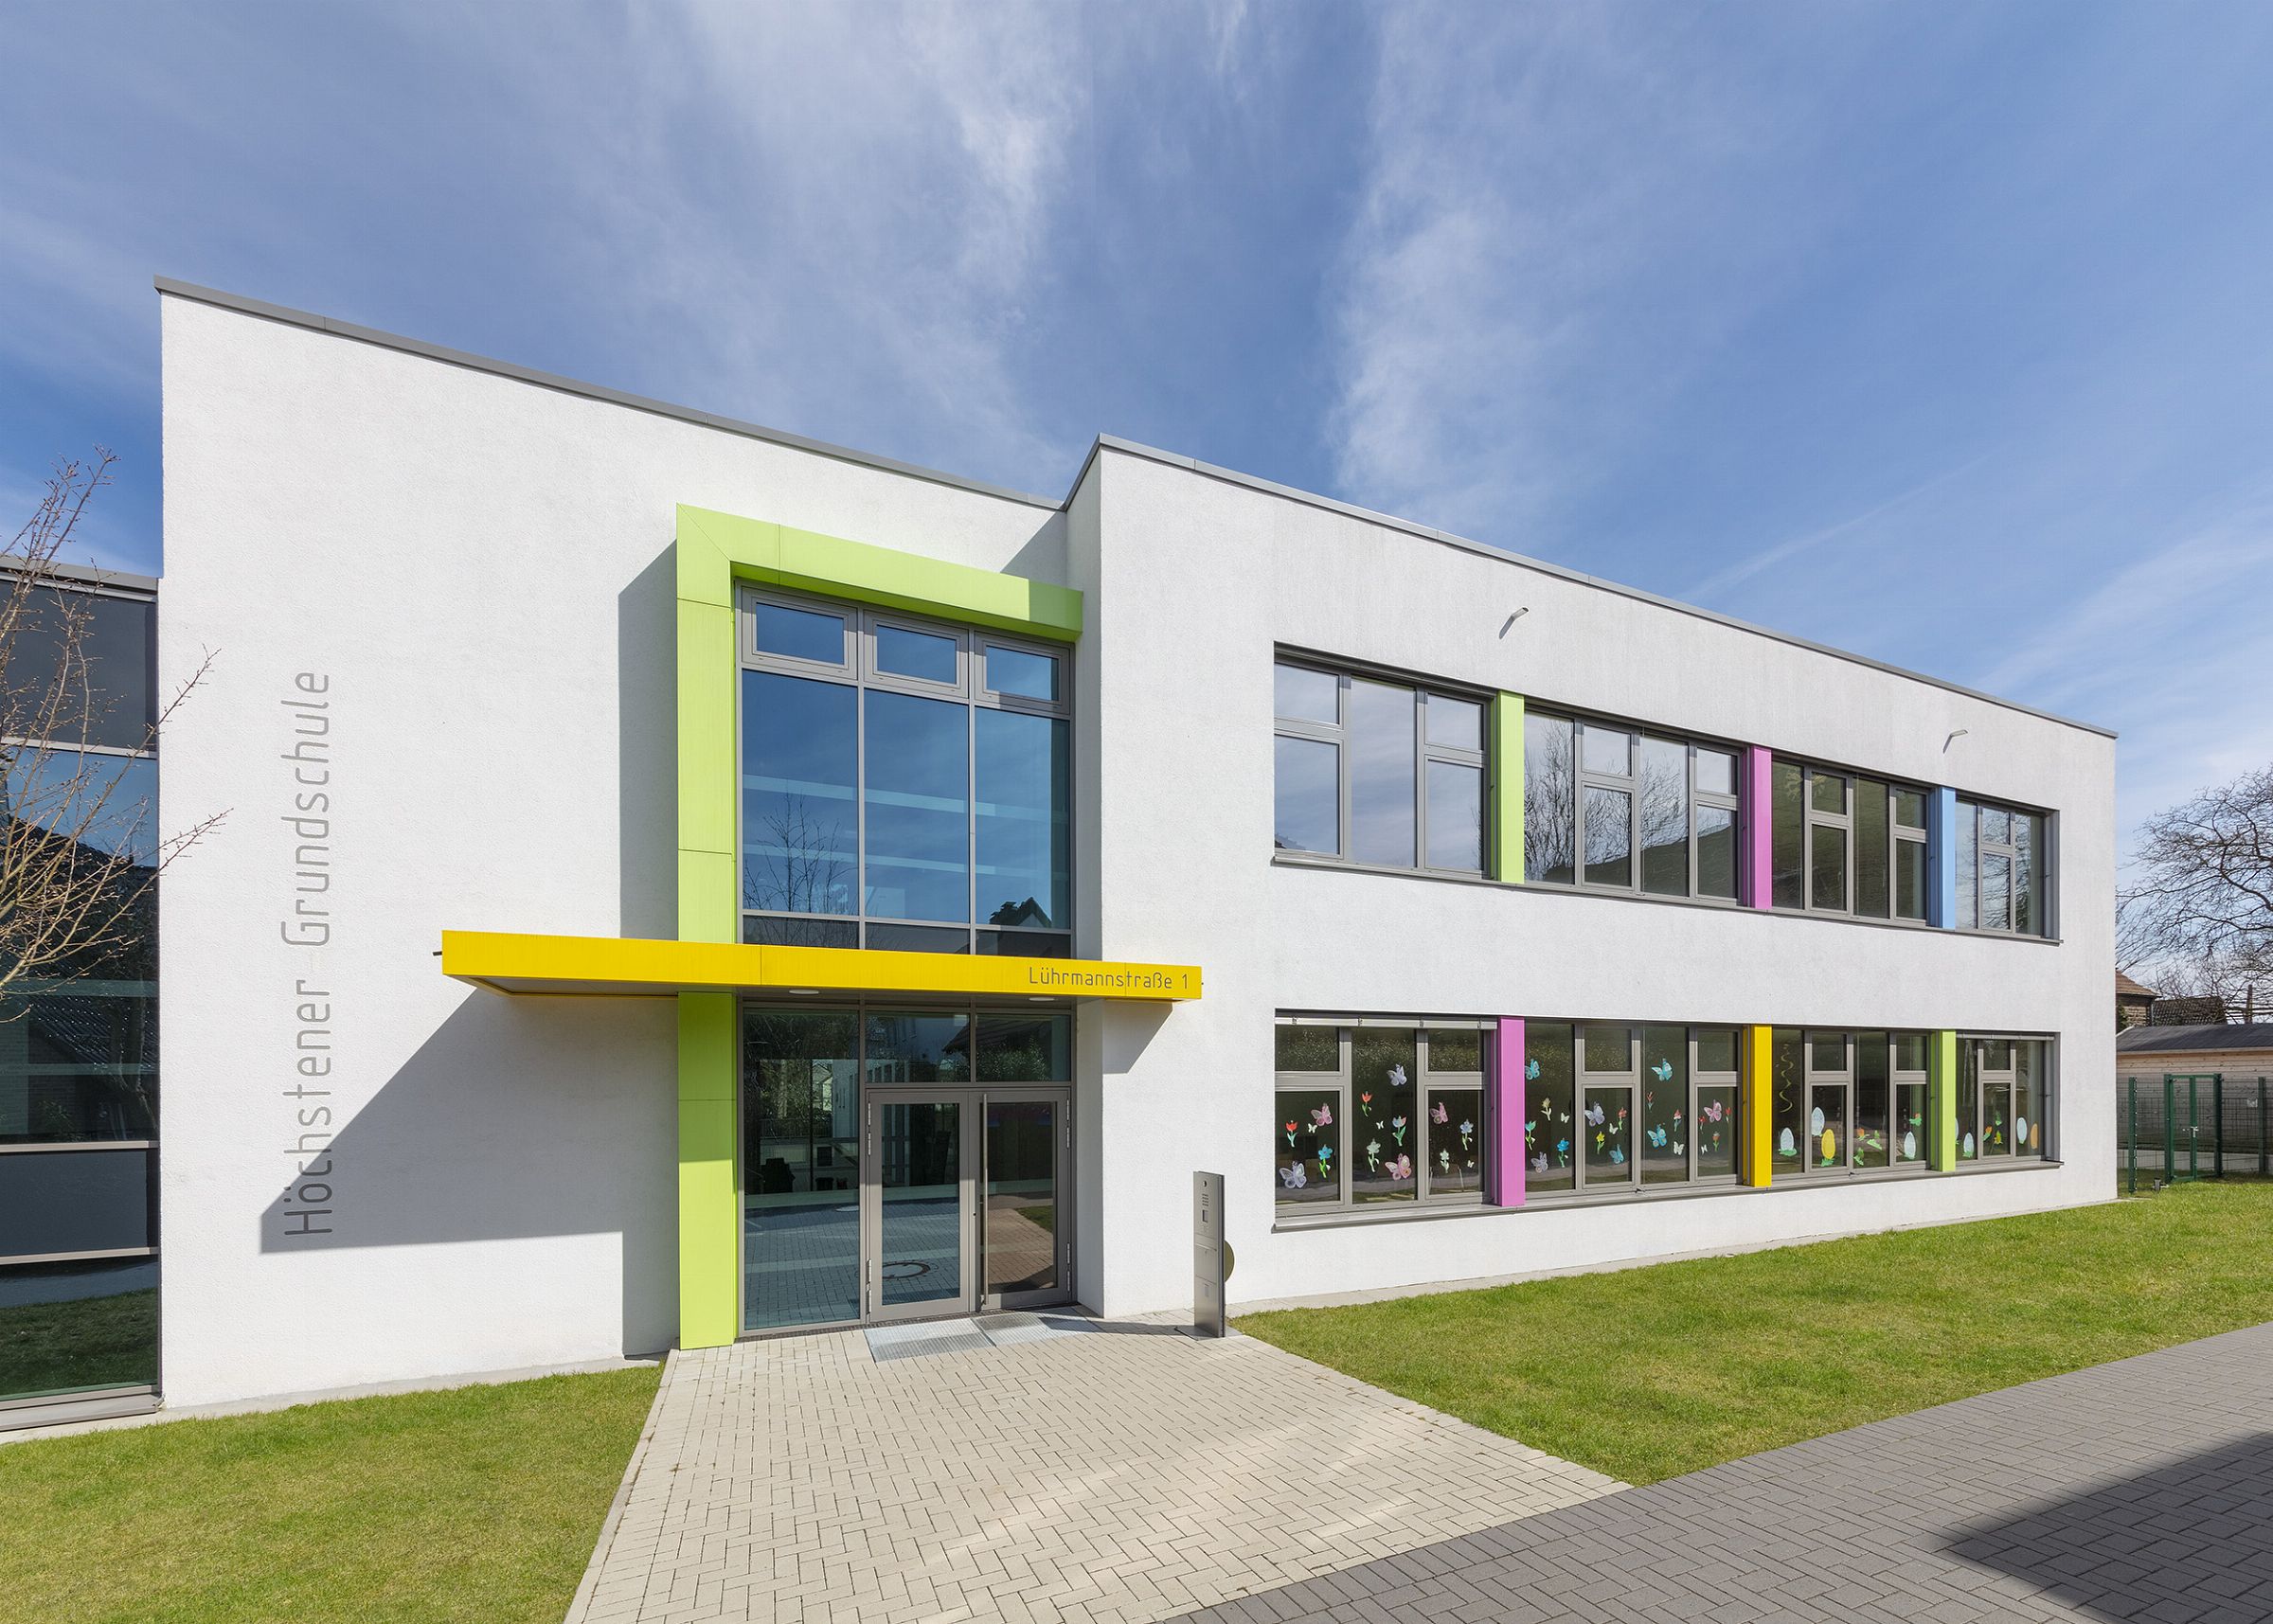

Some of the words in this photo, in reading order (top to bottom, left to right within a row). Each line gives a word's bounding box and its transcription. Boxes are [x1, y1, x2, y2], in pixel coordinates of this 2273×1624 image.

[280, 671, 330, 947] Grundschule
[1029, 967, 1172, 990] Lührmannstraße
[1181, 973, 1188, 990] 1
[283, 979, 332, 1236] Höchstener
